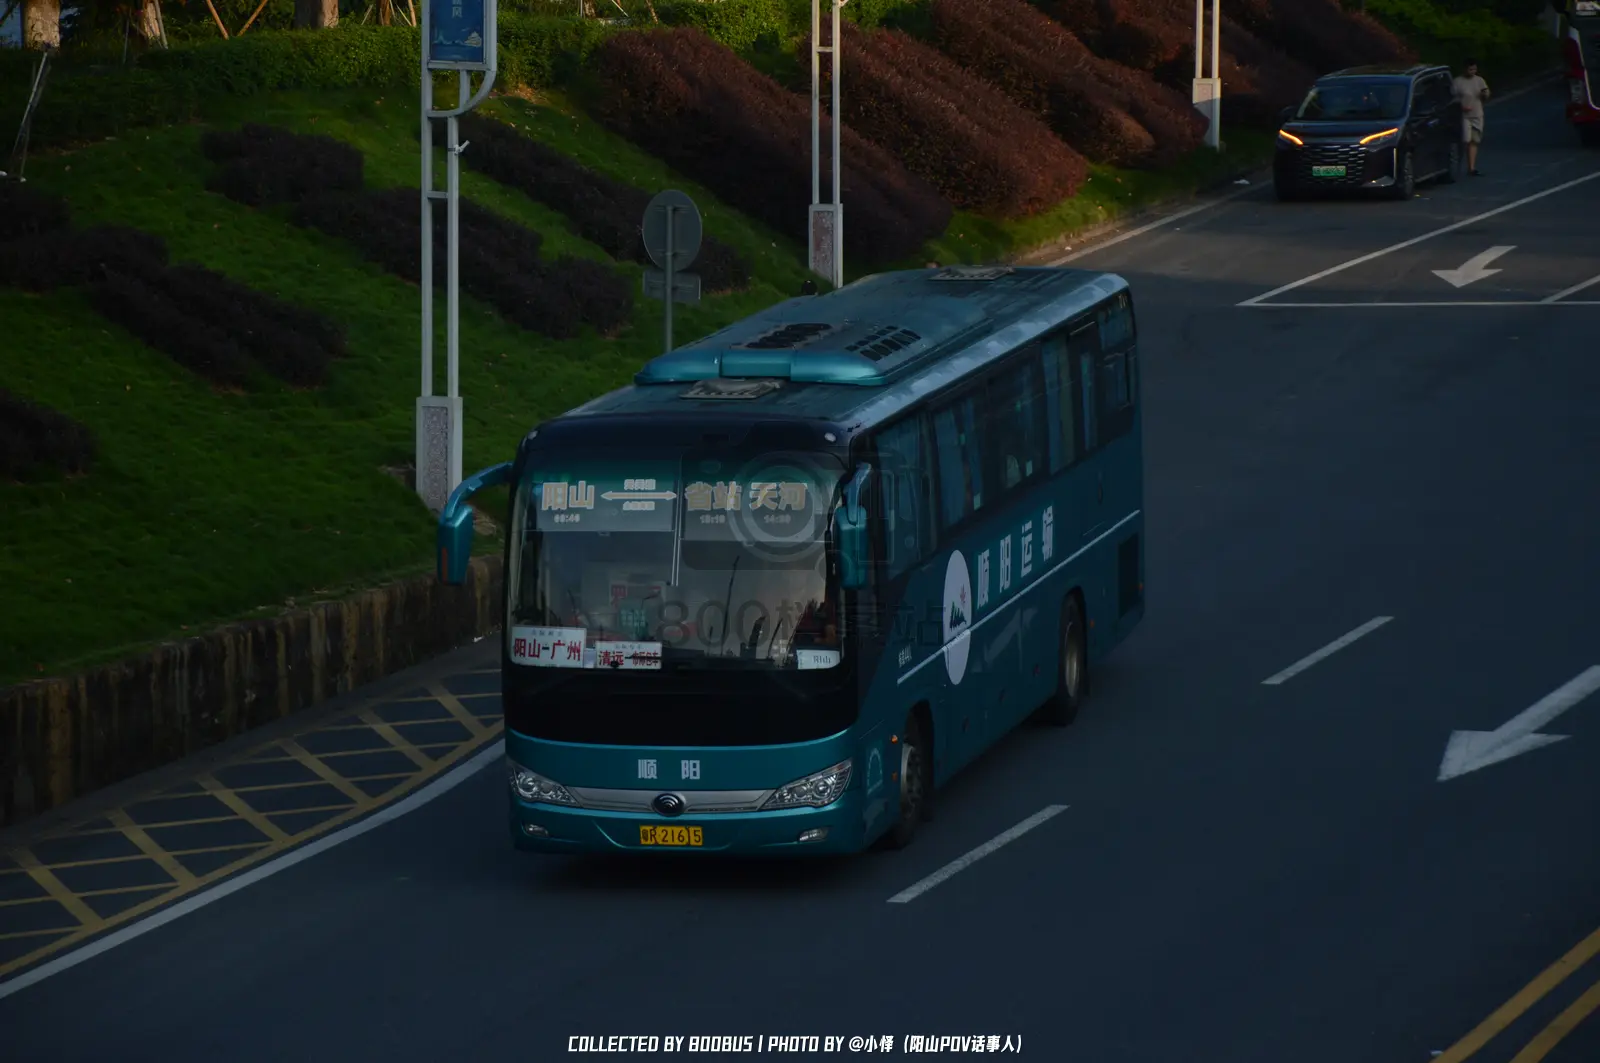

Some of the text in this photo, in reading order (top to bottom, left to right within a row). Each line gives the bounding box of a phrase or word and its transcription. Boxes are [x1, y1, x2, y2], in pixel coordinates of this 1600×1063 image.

[542, 480, 808, 511] 阳山 省站 天河
[976, 504, 1054, 609] 顺阳运输
[514, 638, 581, 661] 阳山-广州
[638, 759, 700, 780] 顺阳
